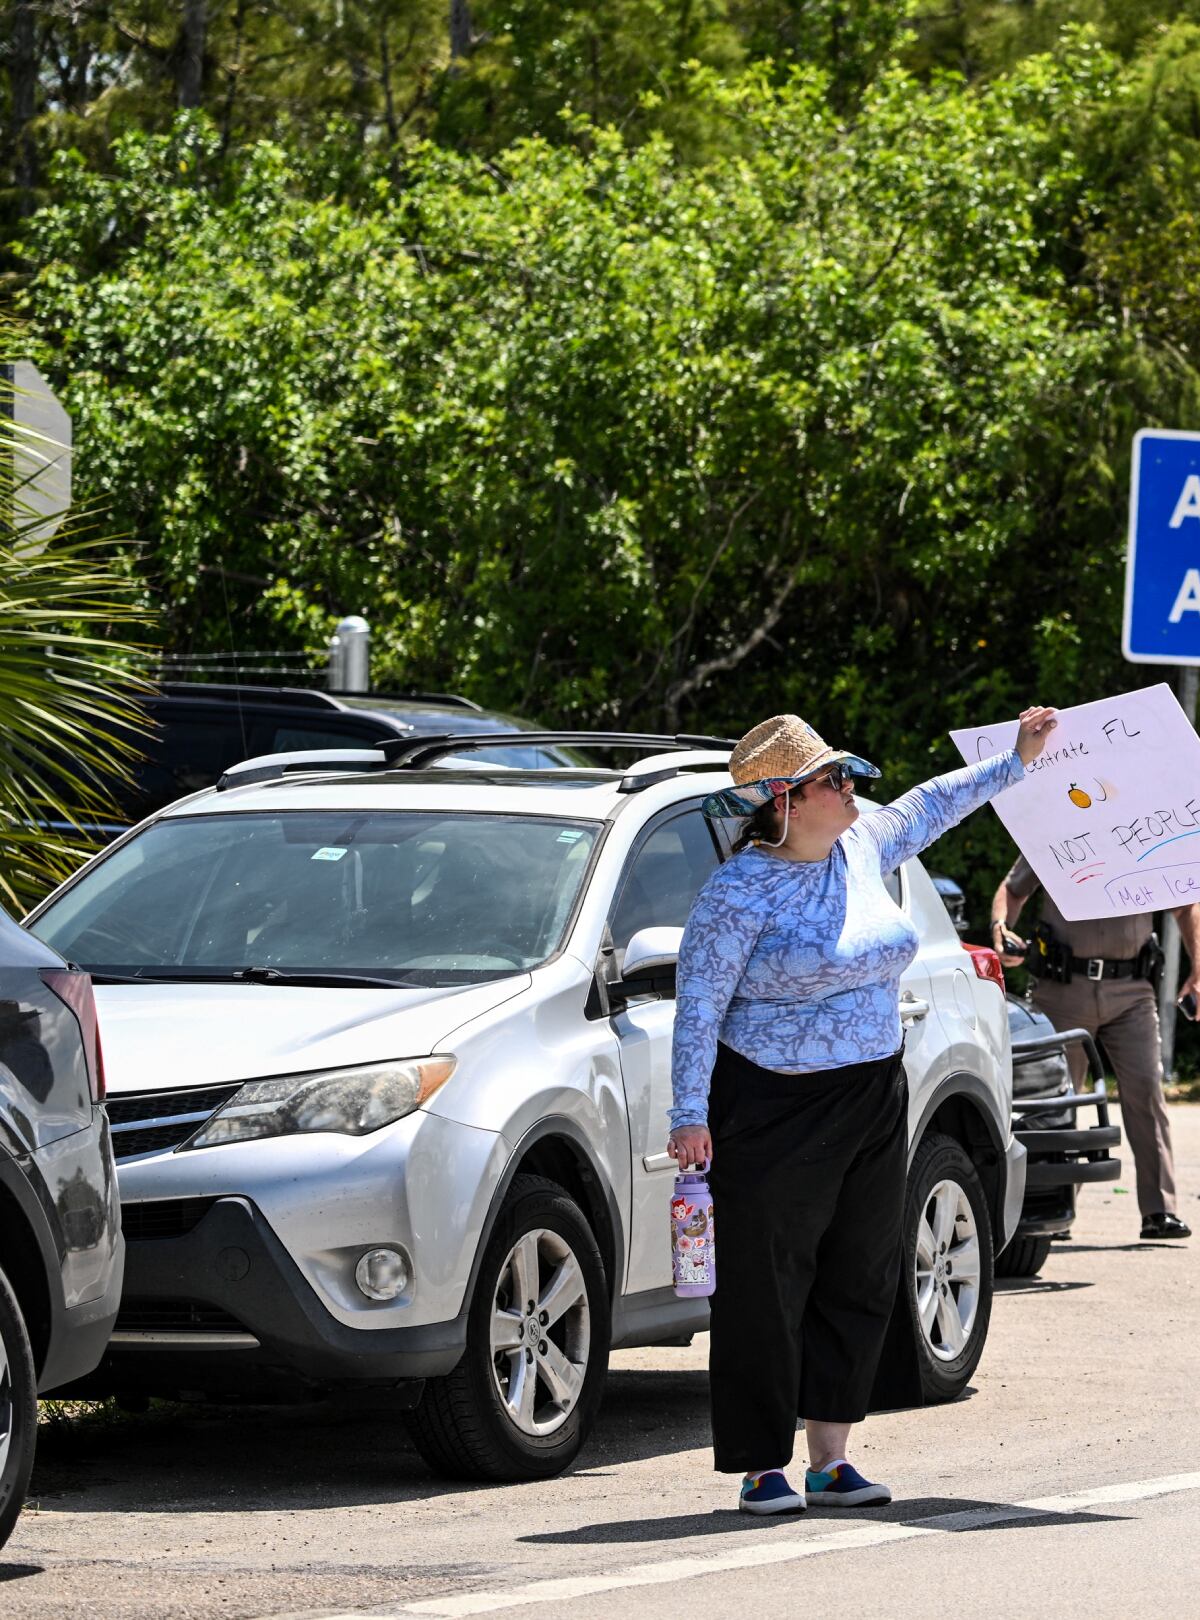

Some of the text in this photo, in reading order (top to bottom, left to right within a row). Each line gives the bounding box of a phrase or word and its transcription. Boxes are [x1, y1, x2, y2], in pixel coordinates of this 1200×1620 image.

[976, 718, 1141, 776] Ccentrate FL
[1048, 832, 1098, 870] NOT
[1117, 881, 1153, 908] Melt
